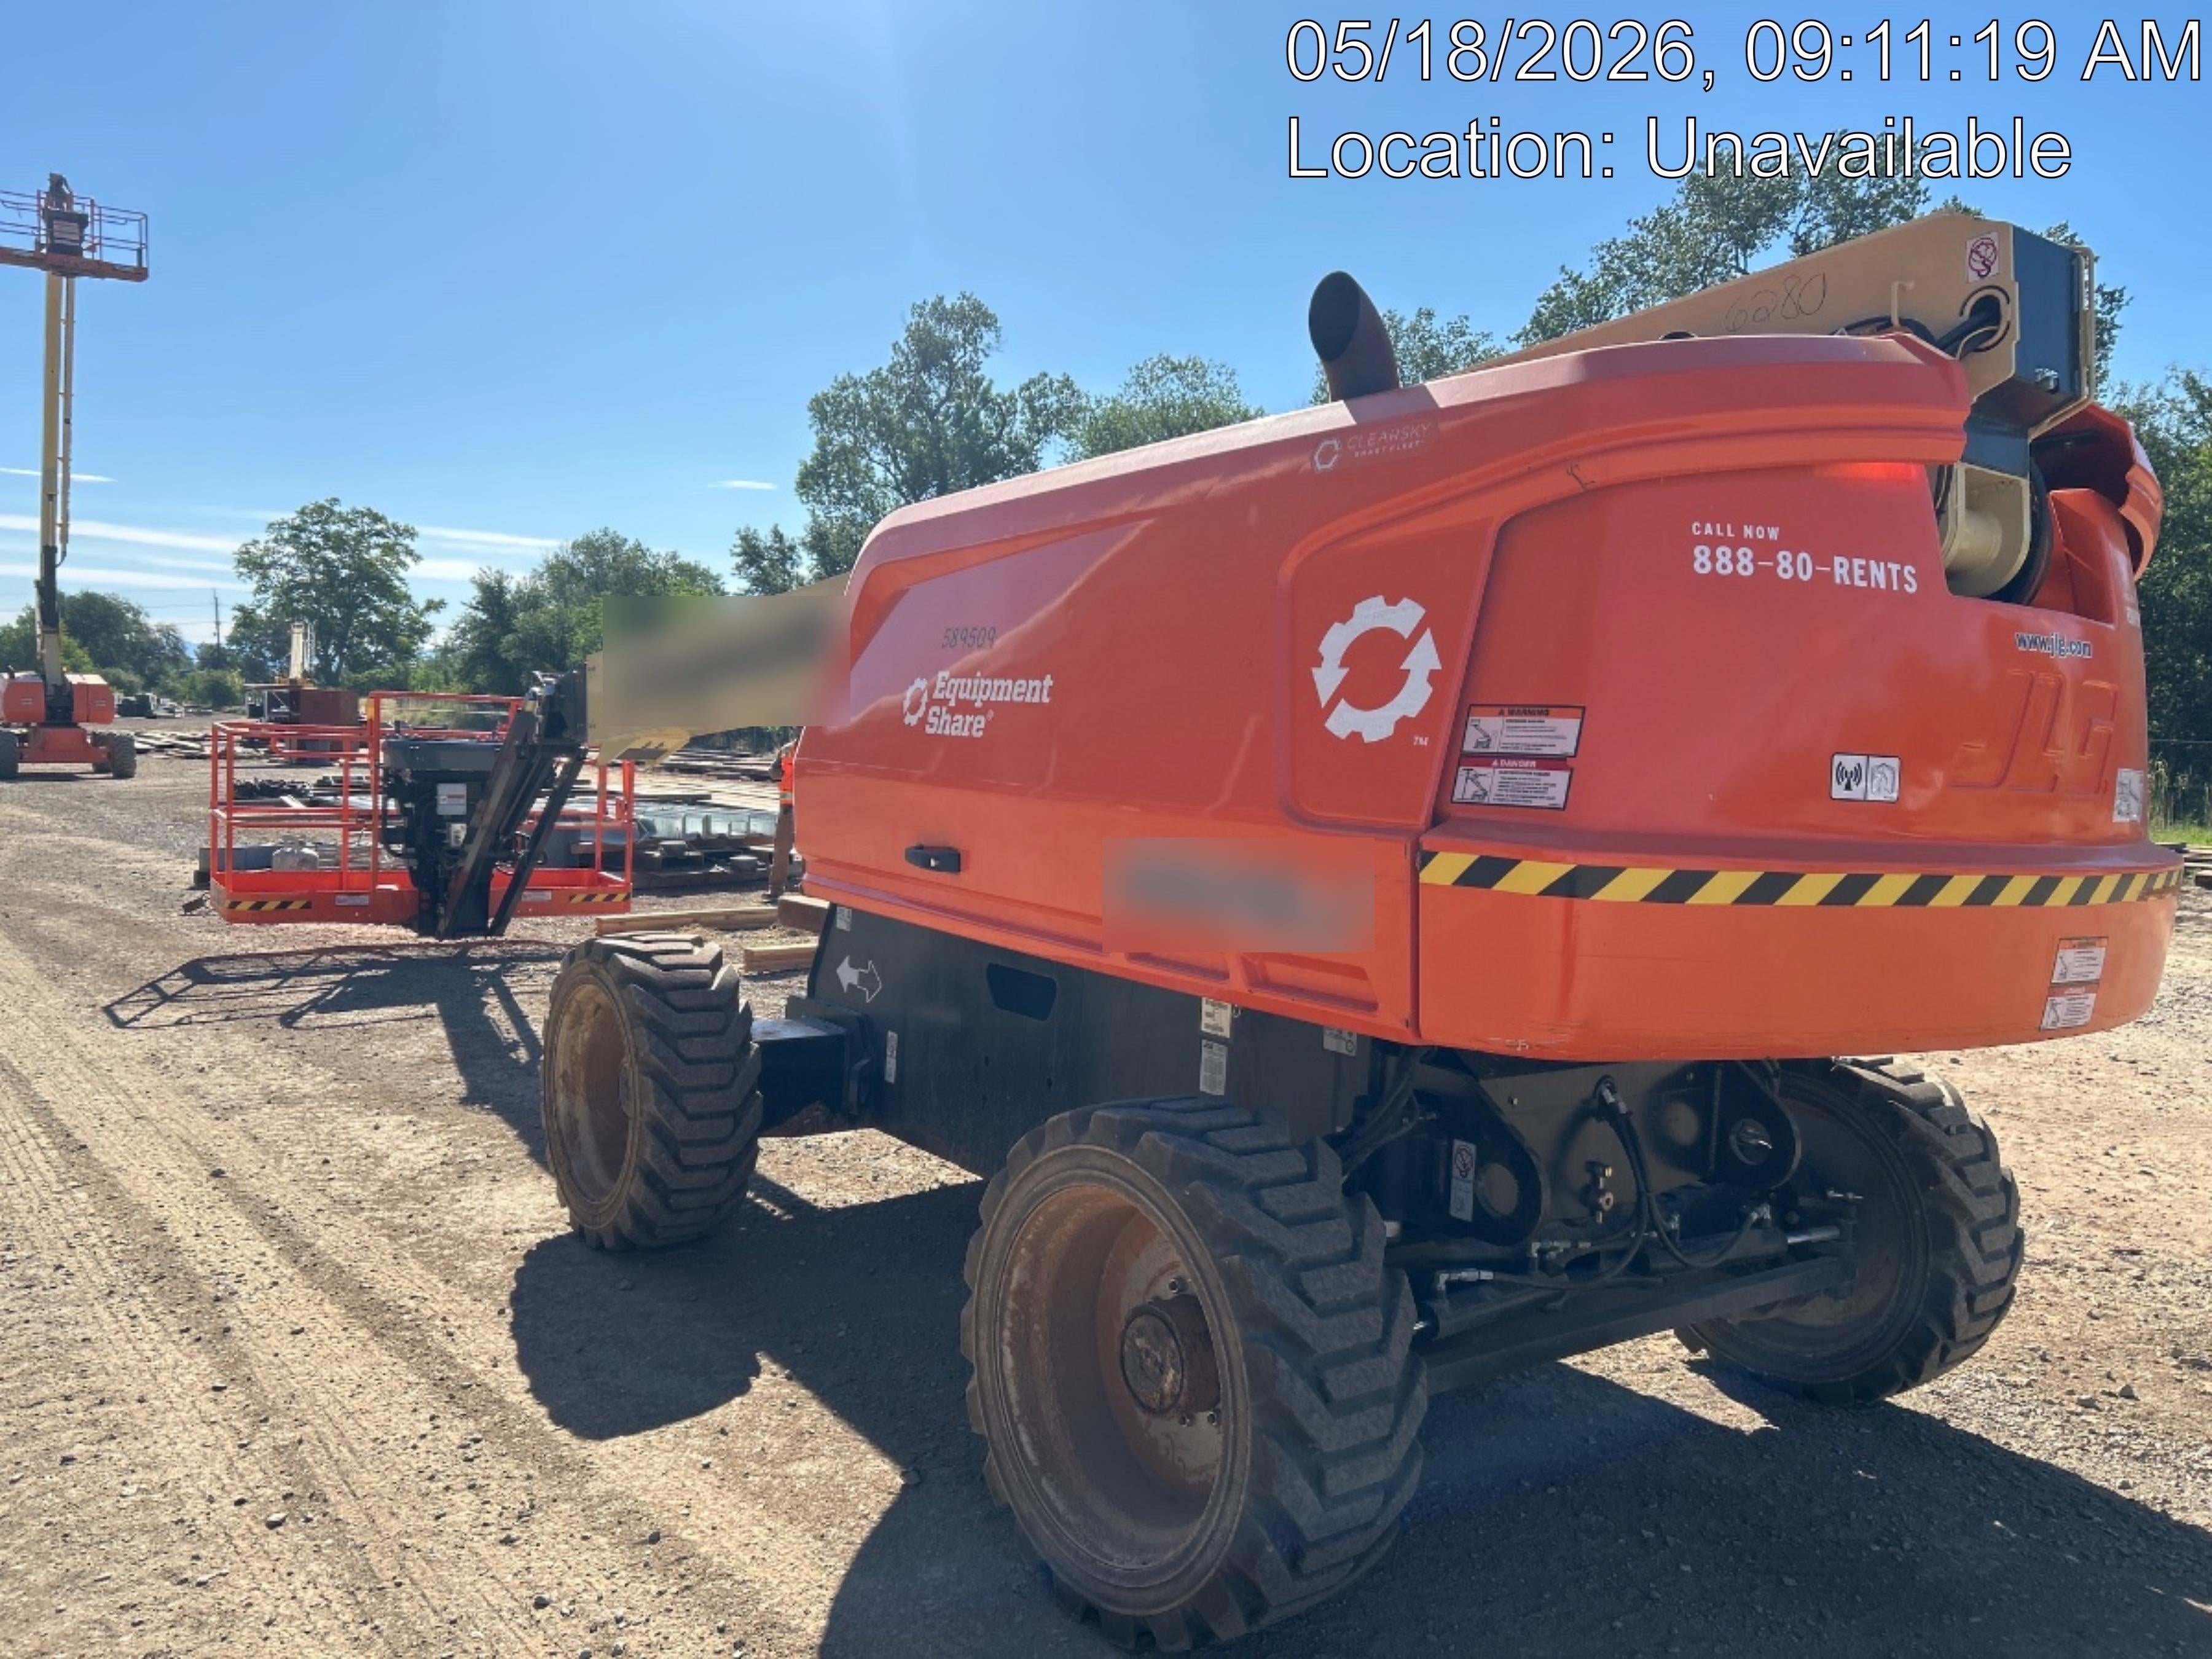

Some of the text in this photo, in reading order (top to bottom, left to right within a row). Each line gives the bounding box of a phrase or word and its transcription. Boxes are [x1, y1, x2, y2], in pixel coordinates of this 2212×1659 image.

[1692, 522, 1779, 540] CALL NOW
[1693, 544, 1918, 594] 888-80-RENTS
[932, 670, 1053, 707] Equipment
